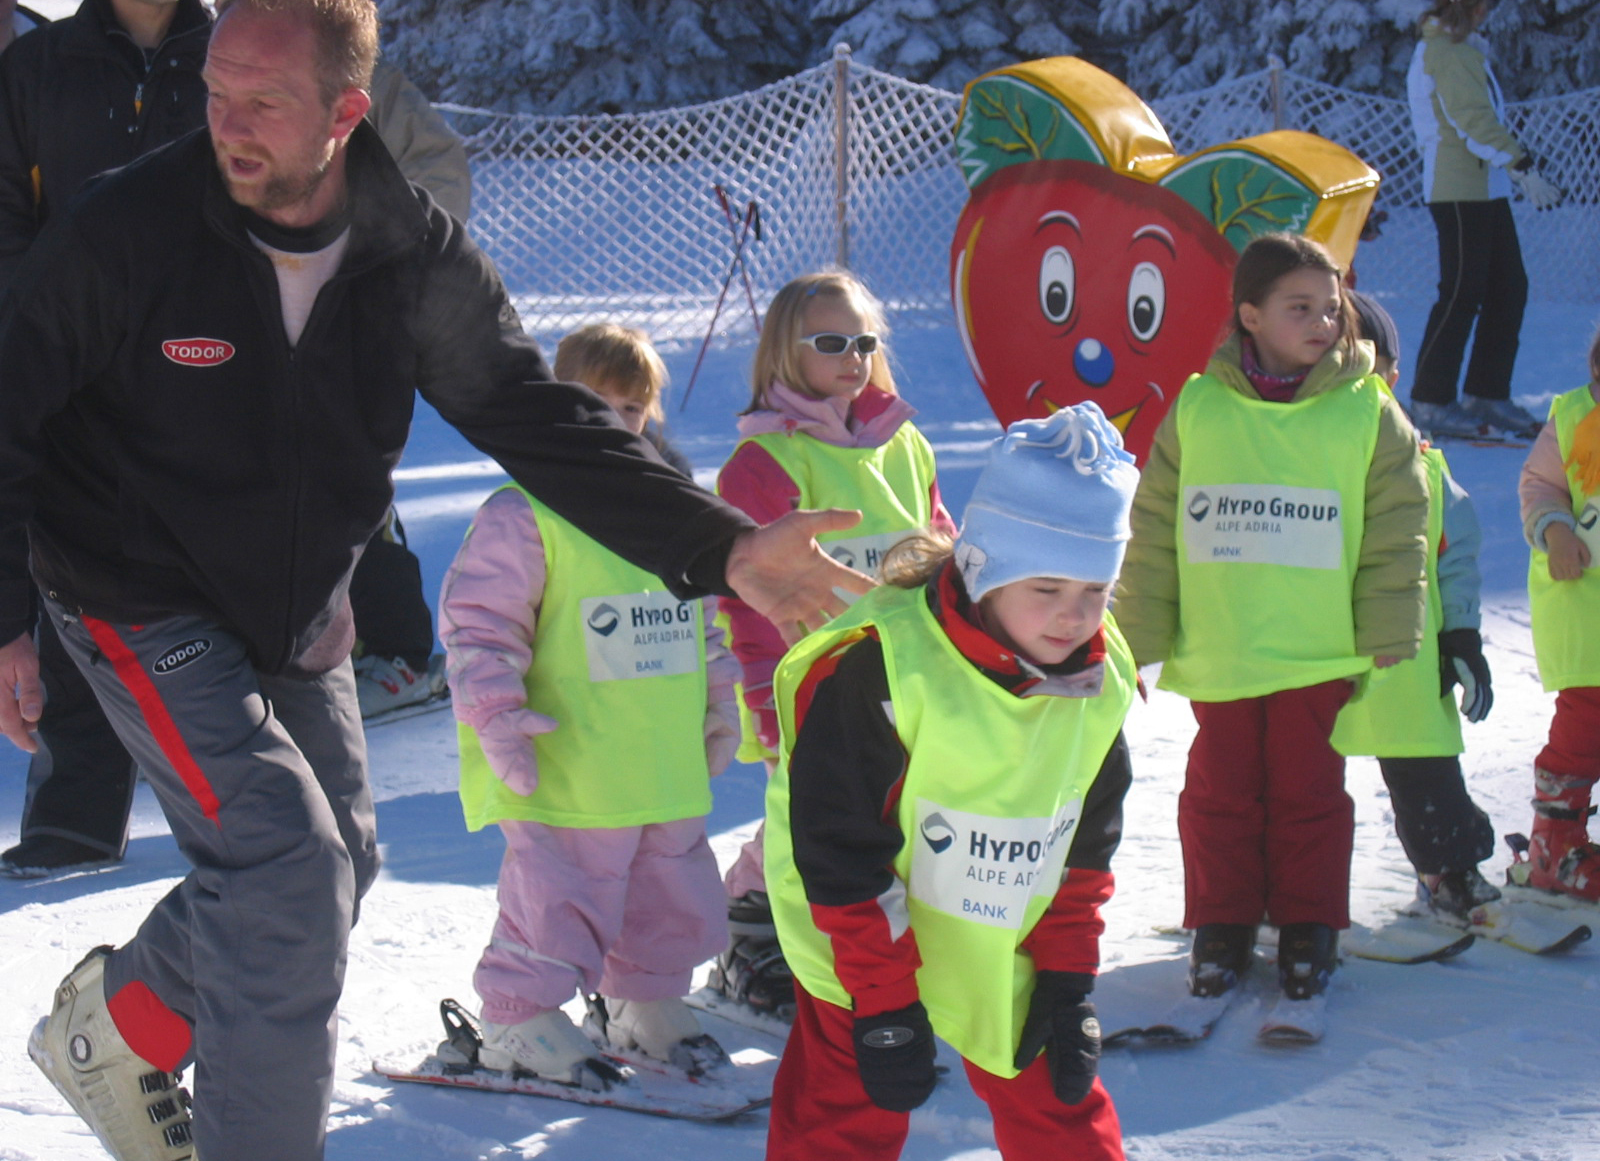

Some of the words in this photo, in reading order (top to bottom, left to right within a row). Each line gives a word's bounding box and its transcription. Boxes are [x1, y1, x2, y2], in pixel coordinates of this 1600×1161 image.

[168, 344, 225, 359] TODOR
[1217, 496, 1266, 516] HYPO
[1270, 497, 1338, 521] GROUP
[1215, 521, 1241, 532] ALPE
[1245, 521, 1282, 534] ADRIA
[1211, 547, 1242, 557] BANK
[631, 606, 672, 628] HYPO
[157, 641, 207, 670] TODOR
[635, 660, 664, 672] BANK
[969, 830, 1041, 863] HYPO
[966, 865, 1007, 885] ALPE
[962, 898, 1008, 920] BANK
